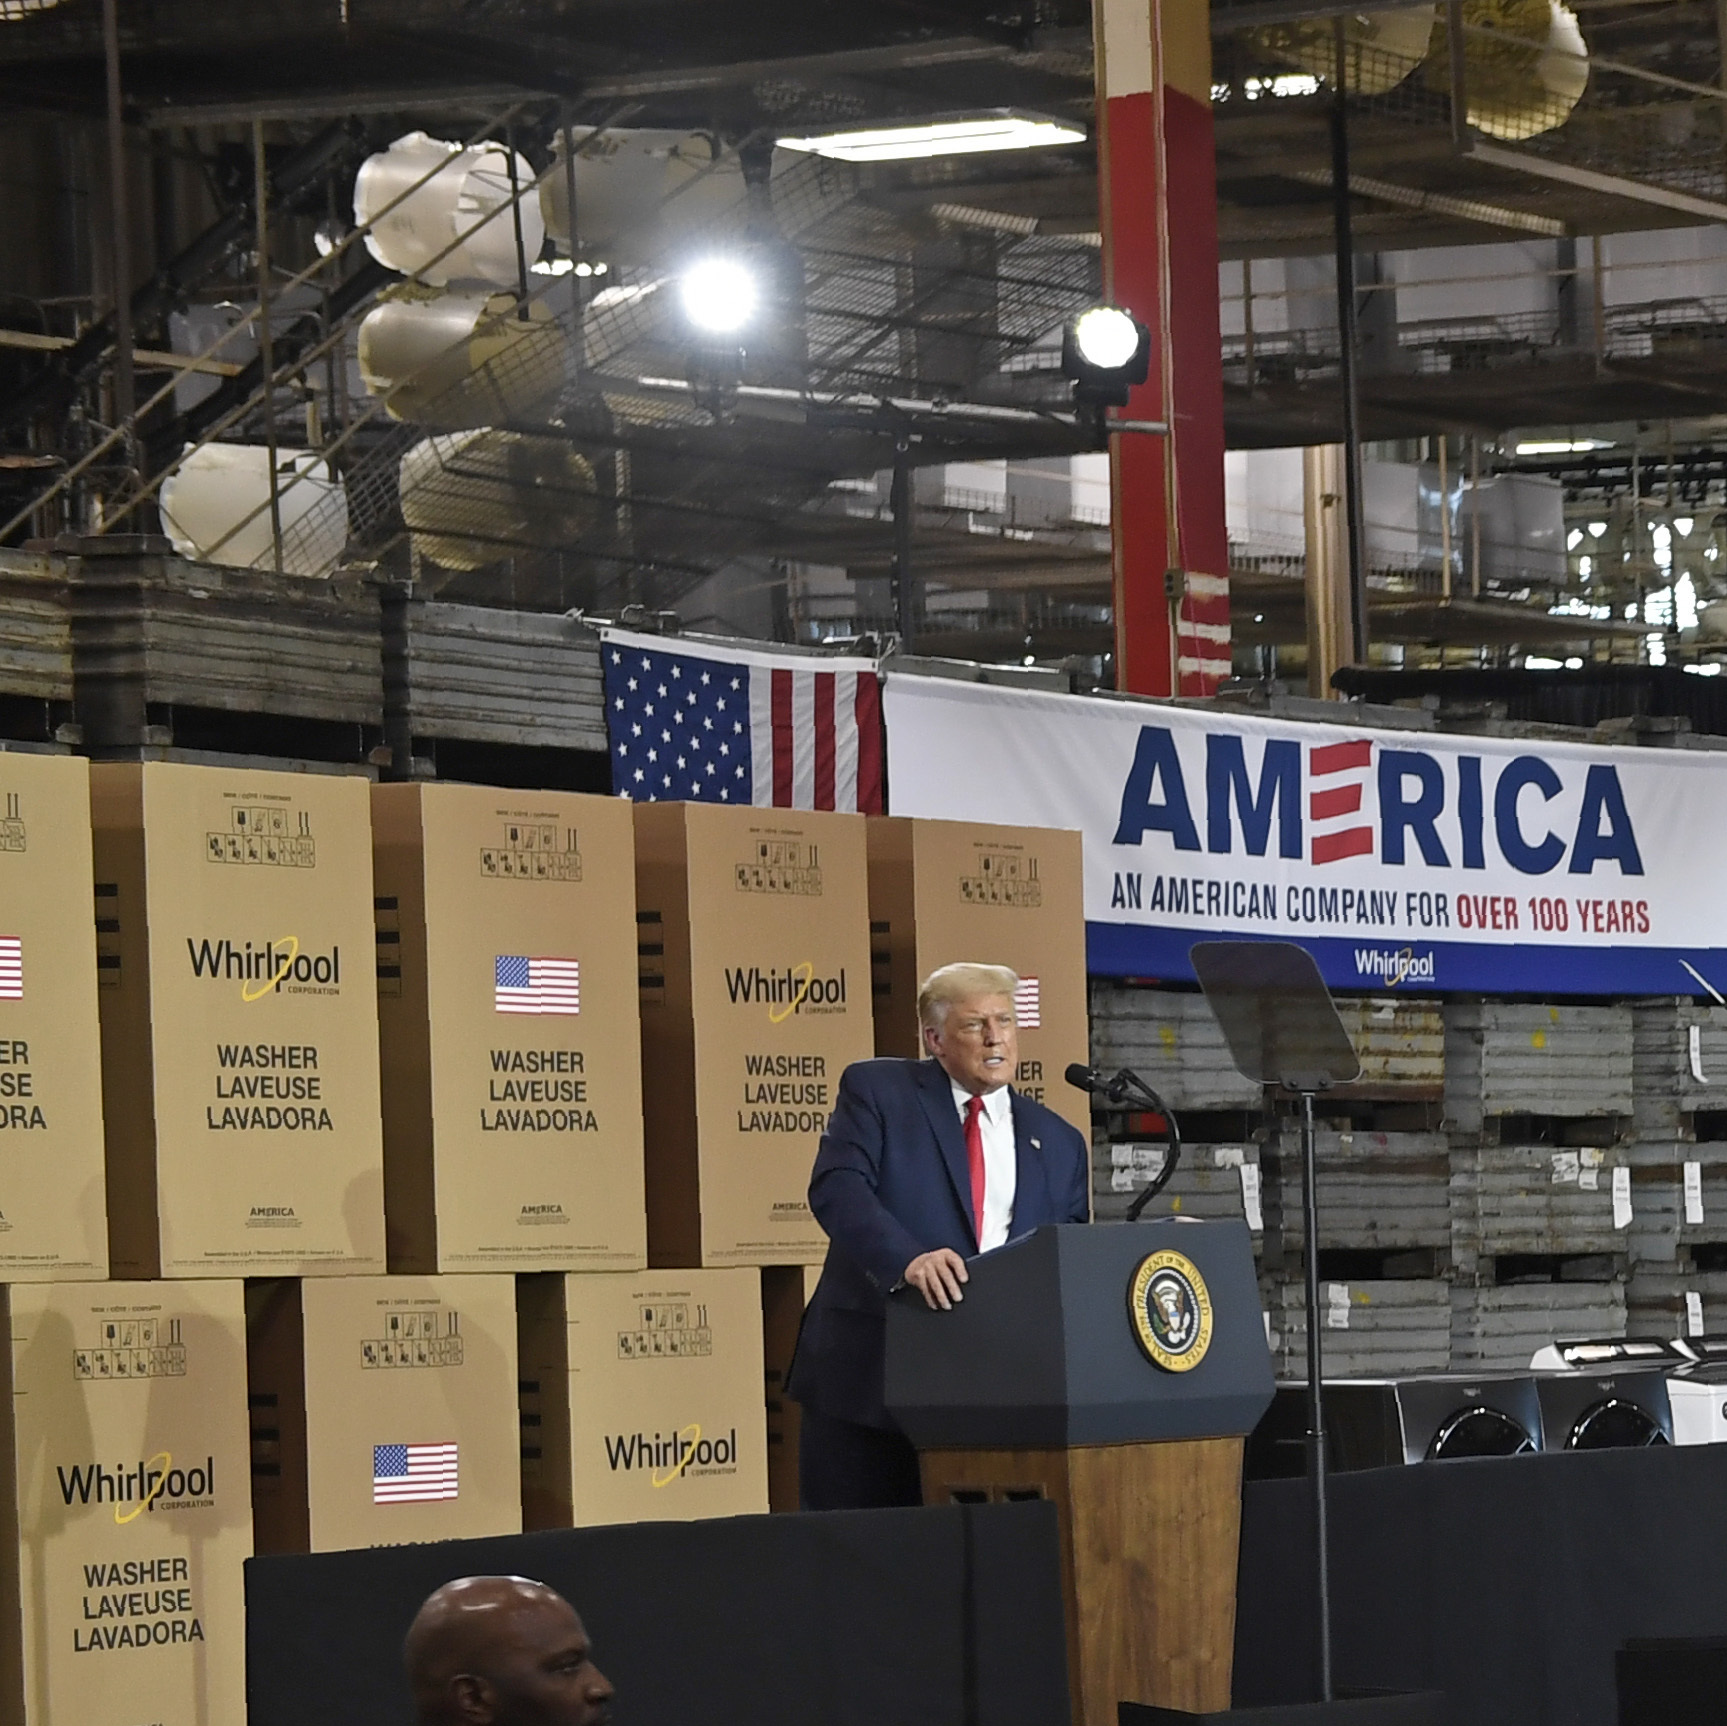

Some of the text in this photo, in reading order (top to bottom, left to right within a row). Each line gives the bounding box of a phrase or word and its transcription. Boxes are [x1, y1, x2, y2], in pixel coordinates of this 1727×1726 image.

[1112, 725, 1645, 876] AMERICA
[1111, 872, 1650, 934] AN AMERICAN COMPANY FOR OVER 100 YEARS
[187, 937, 340, 994] Whirlpool
[1354, 949, 1434, 982] Whirlpool
[288, 985, 340, 996] CORPORATION
[725, 967, 847, 1015] Whirlpool
[217, 1044, 318, 1070] WASHER
[490, 1049, 584, 1074] WASHER
[745, 1055, 826, 1078] WASHER
[216, 1075, 321, 1100] LAVEUSE
[489, 1079, 587, 1103] LAVEUSE
[745, 1083, 828, 1105] LAVEUSE
[207, 1106, 334, 1132] LAVADORA
[481, 1109, 599, 1132] LAVADORA
[250, 1207, 295, 1217] AMERICA
[521, 1204, 564, 1215] AMERICA
[1136, 1255, 1165, 1310] PRESIDENT
[1187, 1264, 1210, 1317] UNITED
[1184, 1328, 1209, 1365] STATES
[605, 1428, 736, 1478] Whirlpool
[56, 1456, 214, 1513] Whirlpool
[160, 1500, 215, 1511] CORPORATION
[84, 1557, 188, 1589] WASHER
[83, 1589, 193, 1620] LAVEUSE
[74, 1619, 205, 1653] LAVADORA
